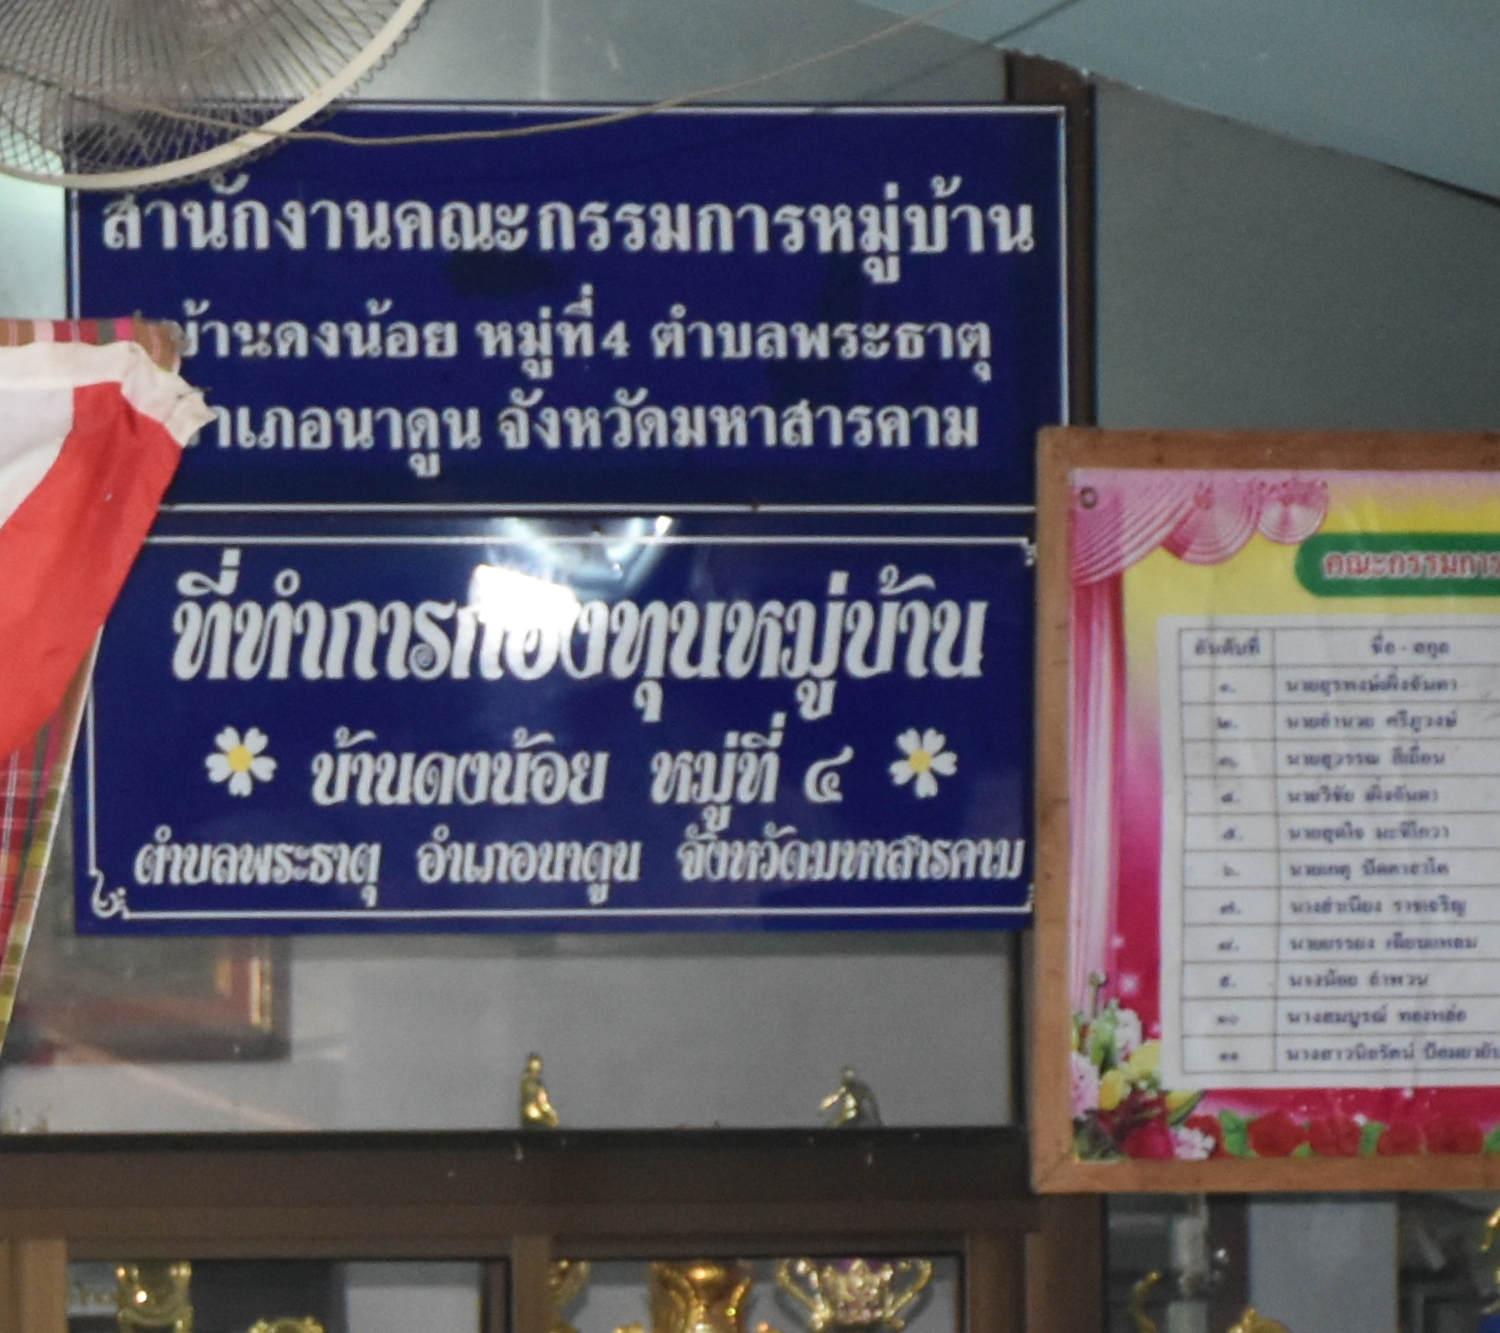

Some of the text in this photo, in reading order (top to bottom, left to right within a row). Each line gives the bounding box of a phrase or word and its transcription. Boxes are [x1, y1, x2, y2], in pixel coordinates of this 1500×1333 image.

[498, 387, 979, 451] จังหวัดมหาสารคาม
[310, 712, 855, 831] บ้านดงน้อย หมู่ที่ ๔
[133, 815, 1025, 908] ตำบลพระธาตุ อำเภอนาดูน จังหวัดมหาสารคาม
